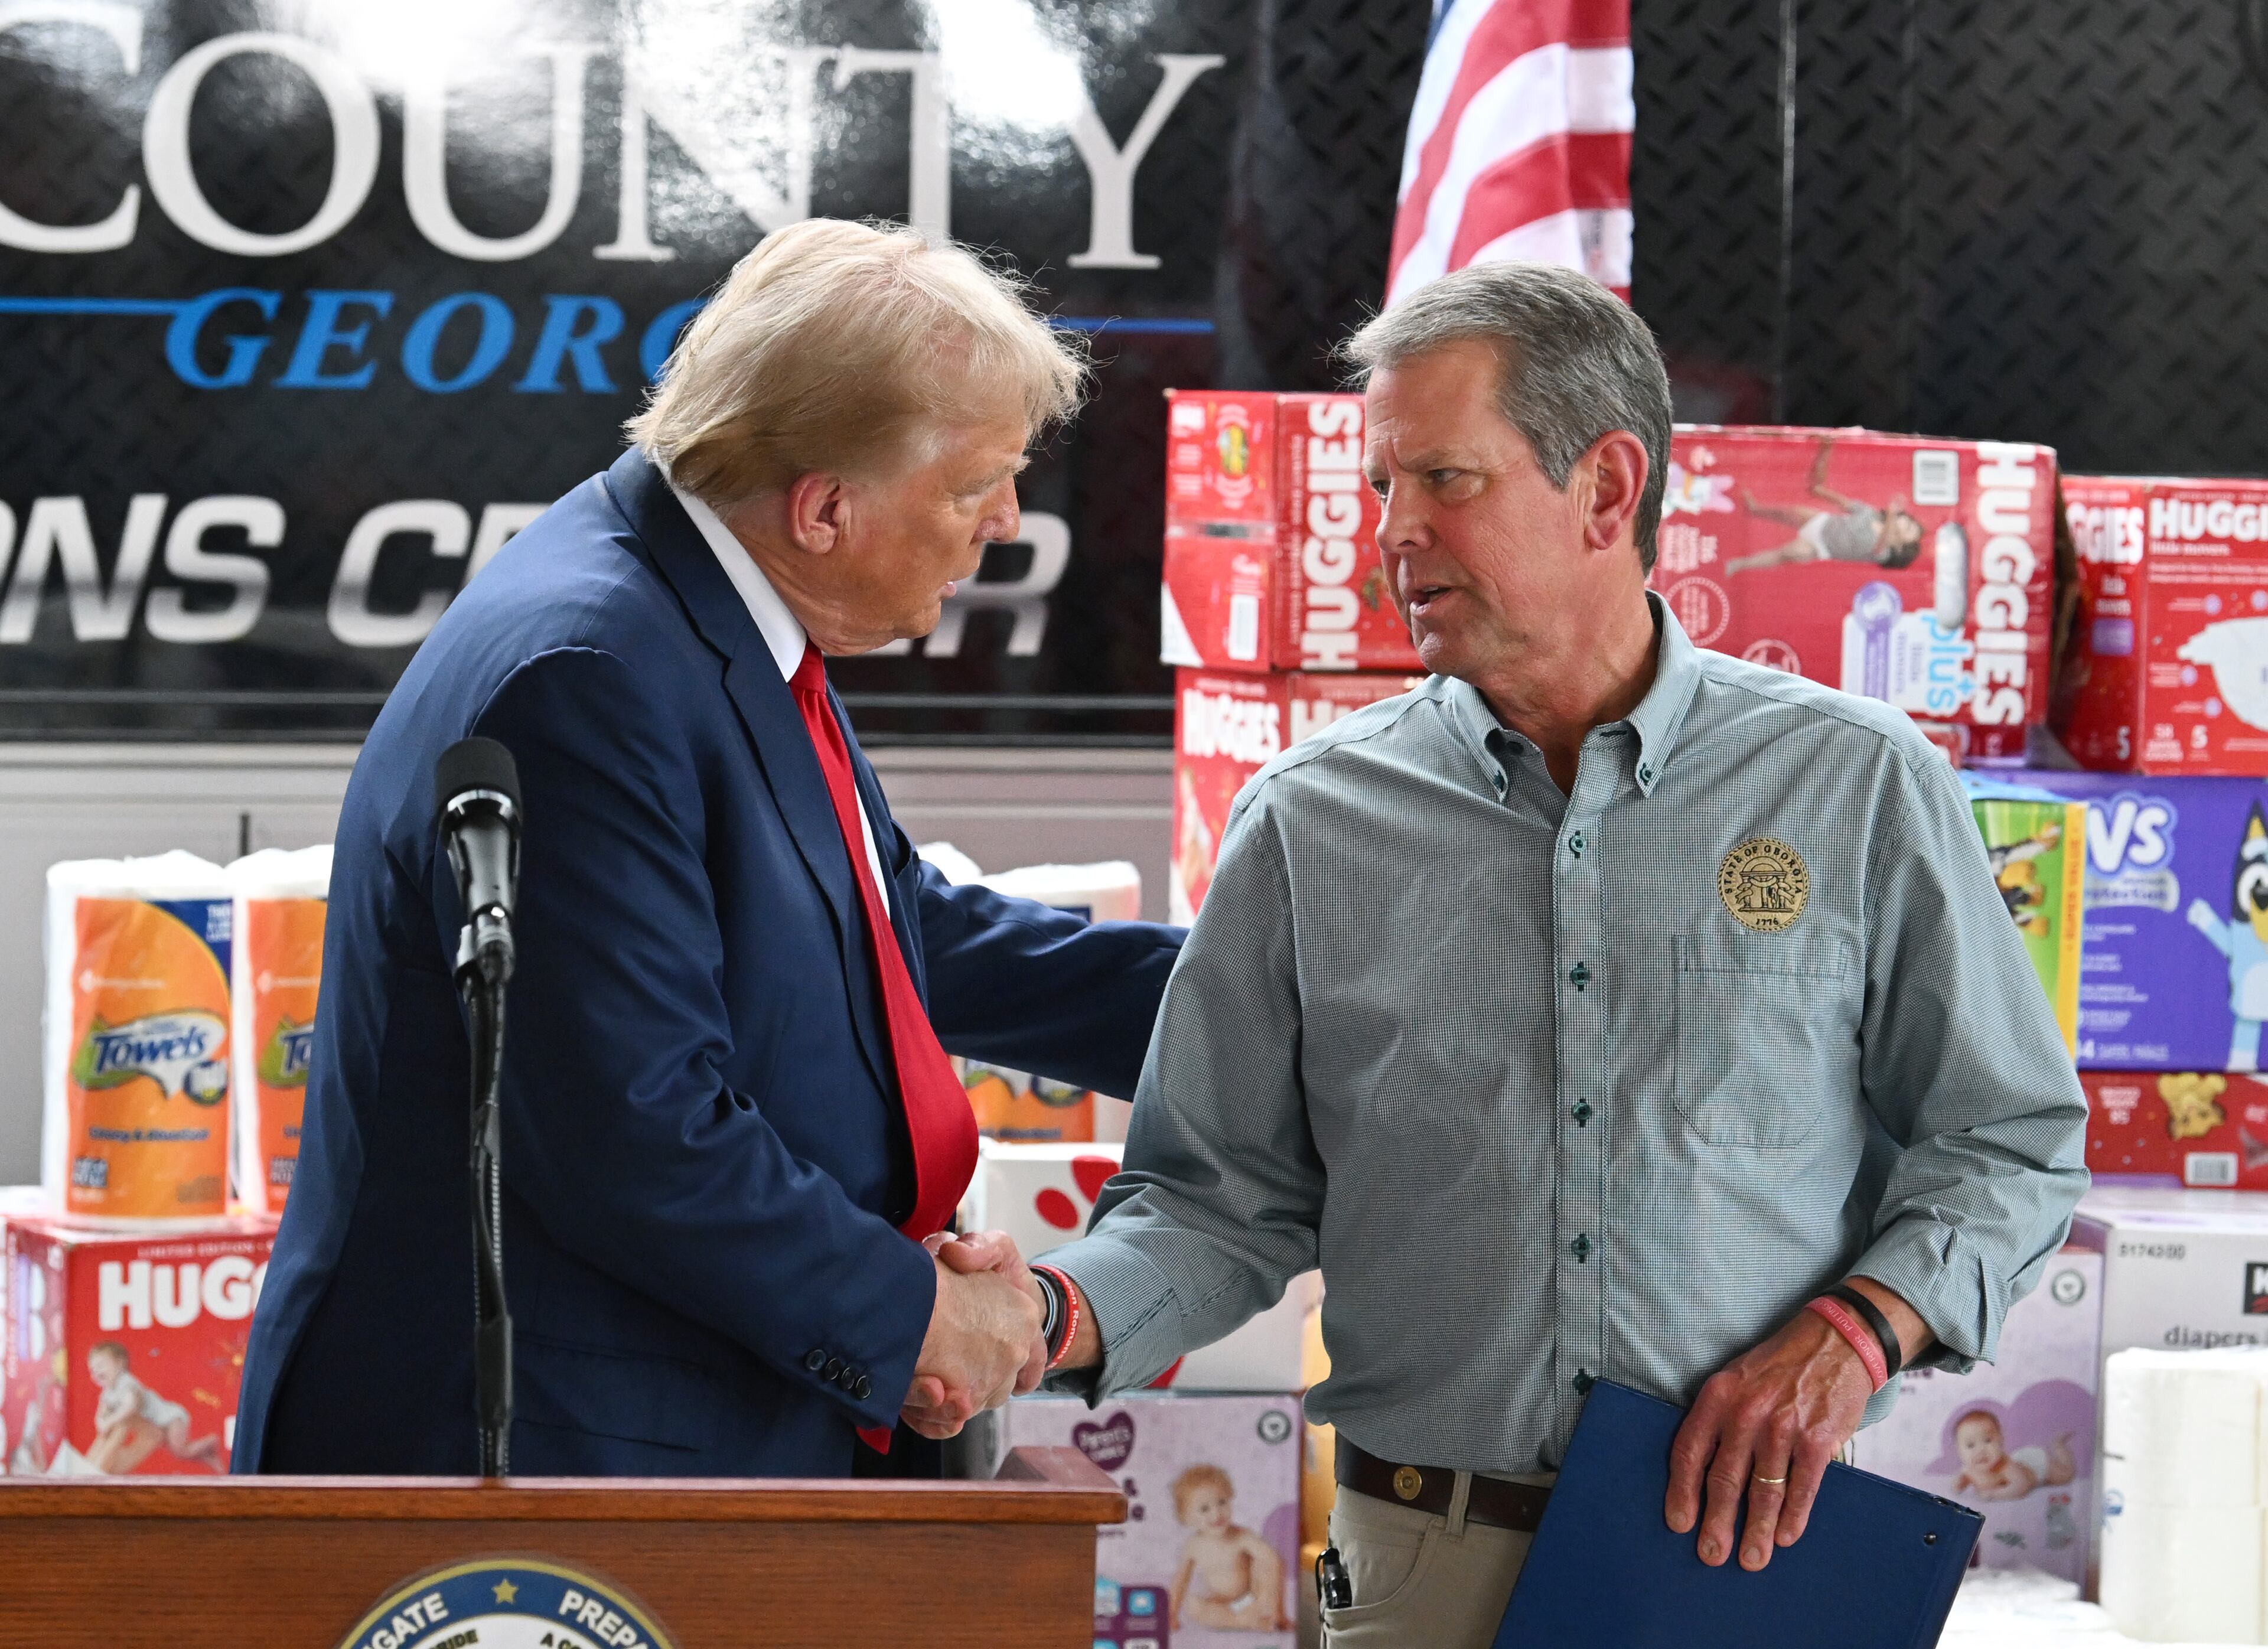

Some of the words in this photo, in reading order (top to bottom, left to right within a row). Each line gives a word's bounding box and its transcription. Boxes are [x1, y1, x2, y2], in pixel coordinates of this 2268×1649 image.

[0, 3, 1226, 269] COUNTY
[1301, 401, 1362, 670] HUGGIES
[2065, 502, 2145, 565] GGIES
[0, 494, 286, 645] NS
[1972, 443, 2038, 725] HUGGIES
[2088, 800, 2169, 872] VS
[1724, 855, 1743, 894] STATE
[1744, 846, 1758, 857] OF
[1764, 845, 1803, 894] GEORGIA
[1756, 917, 1779, 925] 1776
[94, 1026, 204, 1072] Towels
[2164, 1327, 2259, 1349] diapers
[362, 1592, 449, 1649] GATE
